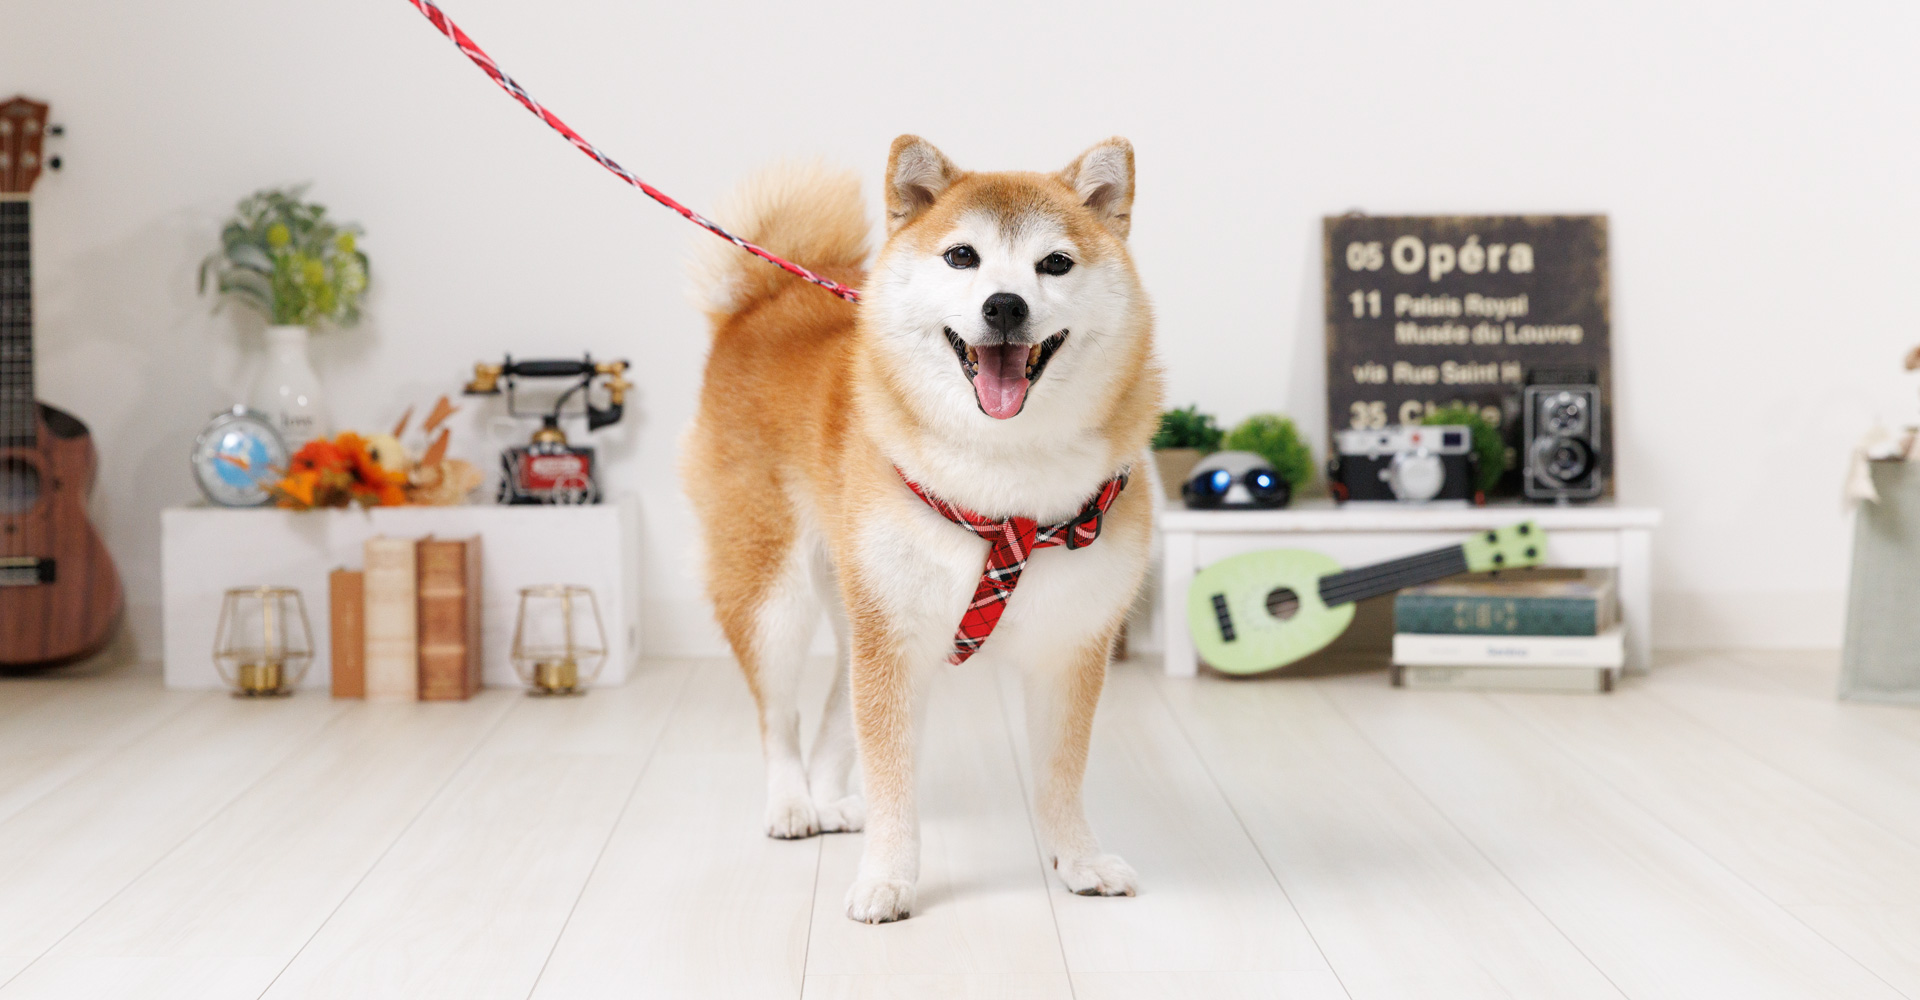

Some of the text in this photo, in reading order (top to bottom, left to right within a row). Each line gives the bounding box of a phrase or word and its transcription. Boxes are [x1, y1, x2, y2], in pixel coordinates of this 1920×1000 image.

[1346, 235, 1534, 281] 05 Opéra
[1349, 289, 1528, 320] 11 Palais Royal
[1395, 322, 1583, 344] Musée du Louvre
[1353, 361, 1387, 384] via
[1393, 362, 1438, 384] Rue
[1441, 361, 1498, 384] Saint
[1351, 401, 1387, 427] 35
